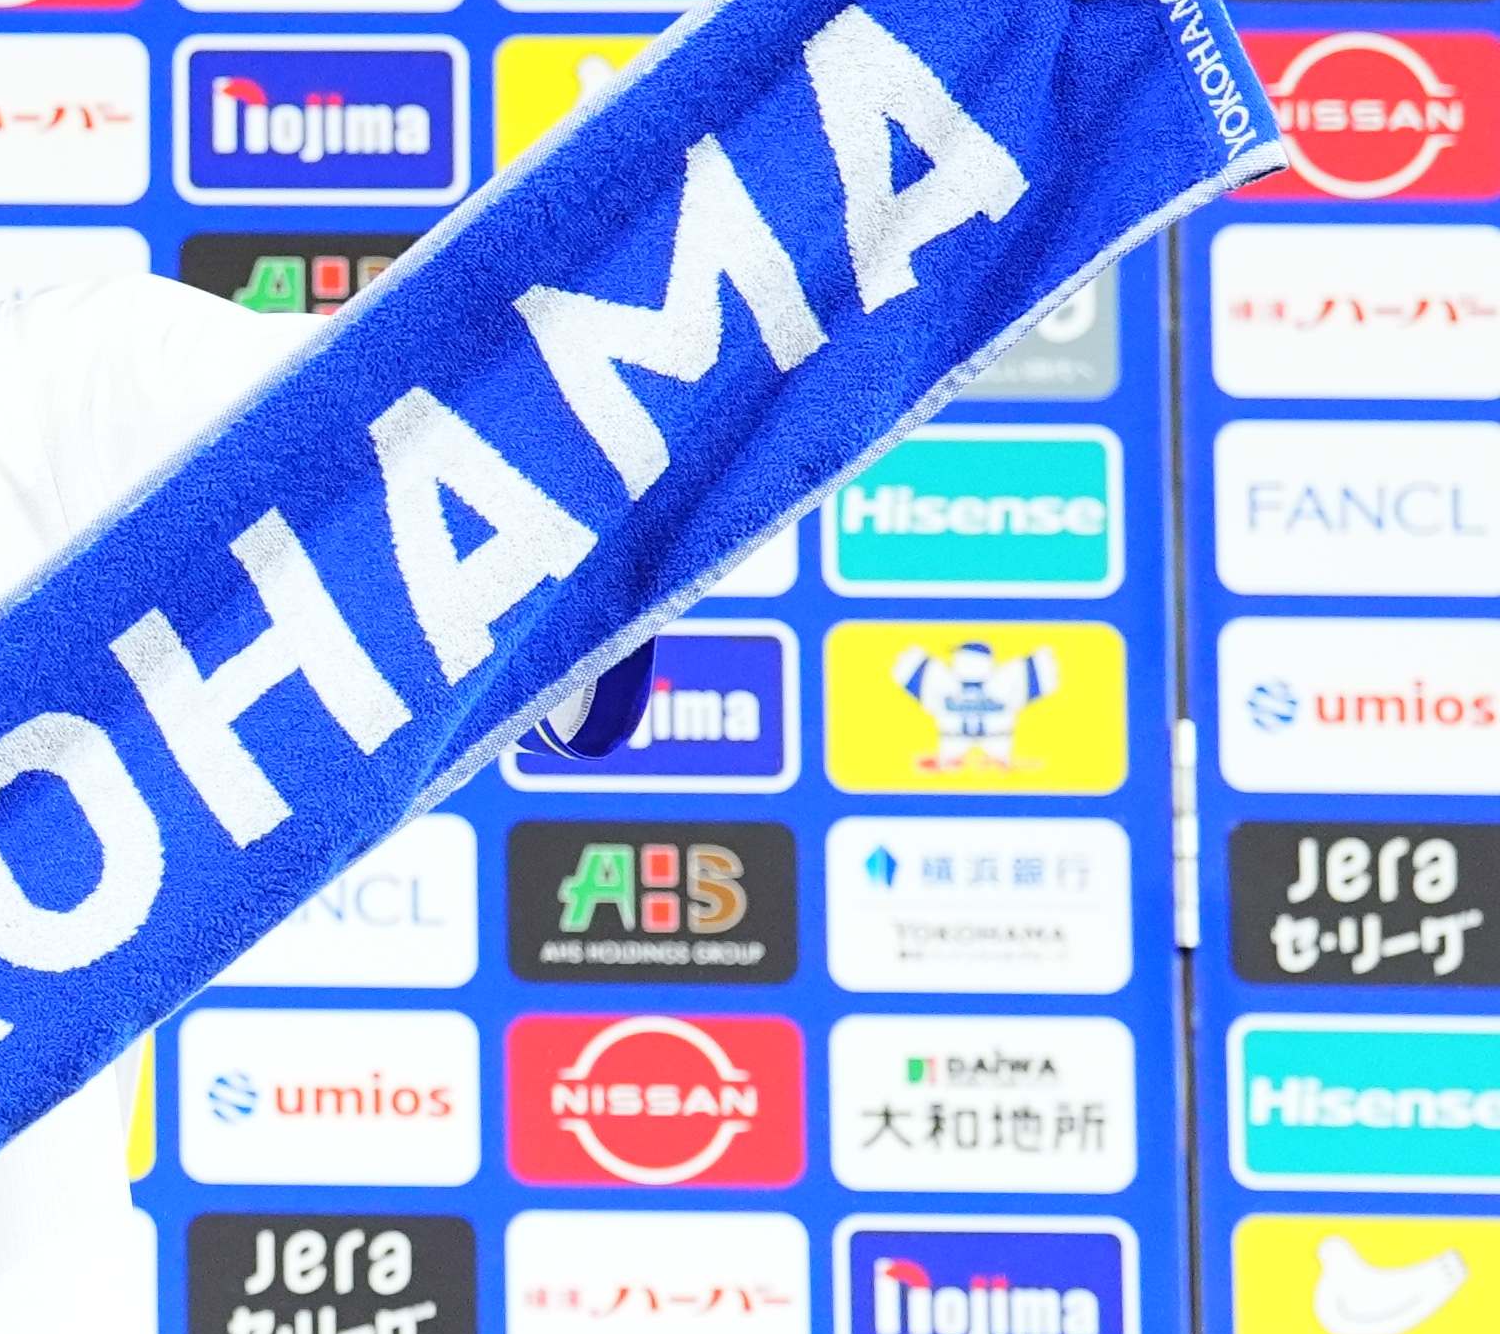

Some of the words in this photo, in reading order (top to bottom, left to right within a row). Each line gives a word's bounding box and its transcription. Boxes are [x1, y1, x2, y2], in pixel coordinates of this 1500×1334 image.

[1246, 482, 1486, 535] FANCL
[1316, 682, 1498, 724] umios
[920, 854, 1088, 888] 横浜銀行
[275, 1073, 452, 1116] umios
[552, 1084, 758, 1116] NISSAN
[864, 1102, 1105, 1151] 大和地所
